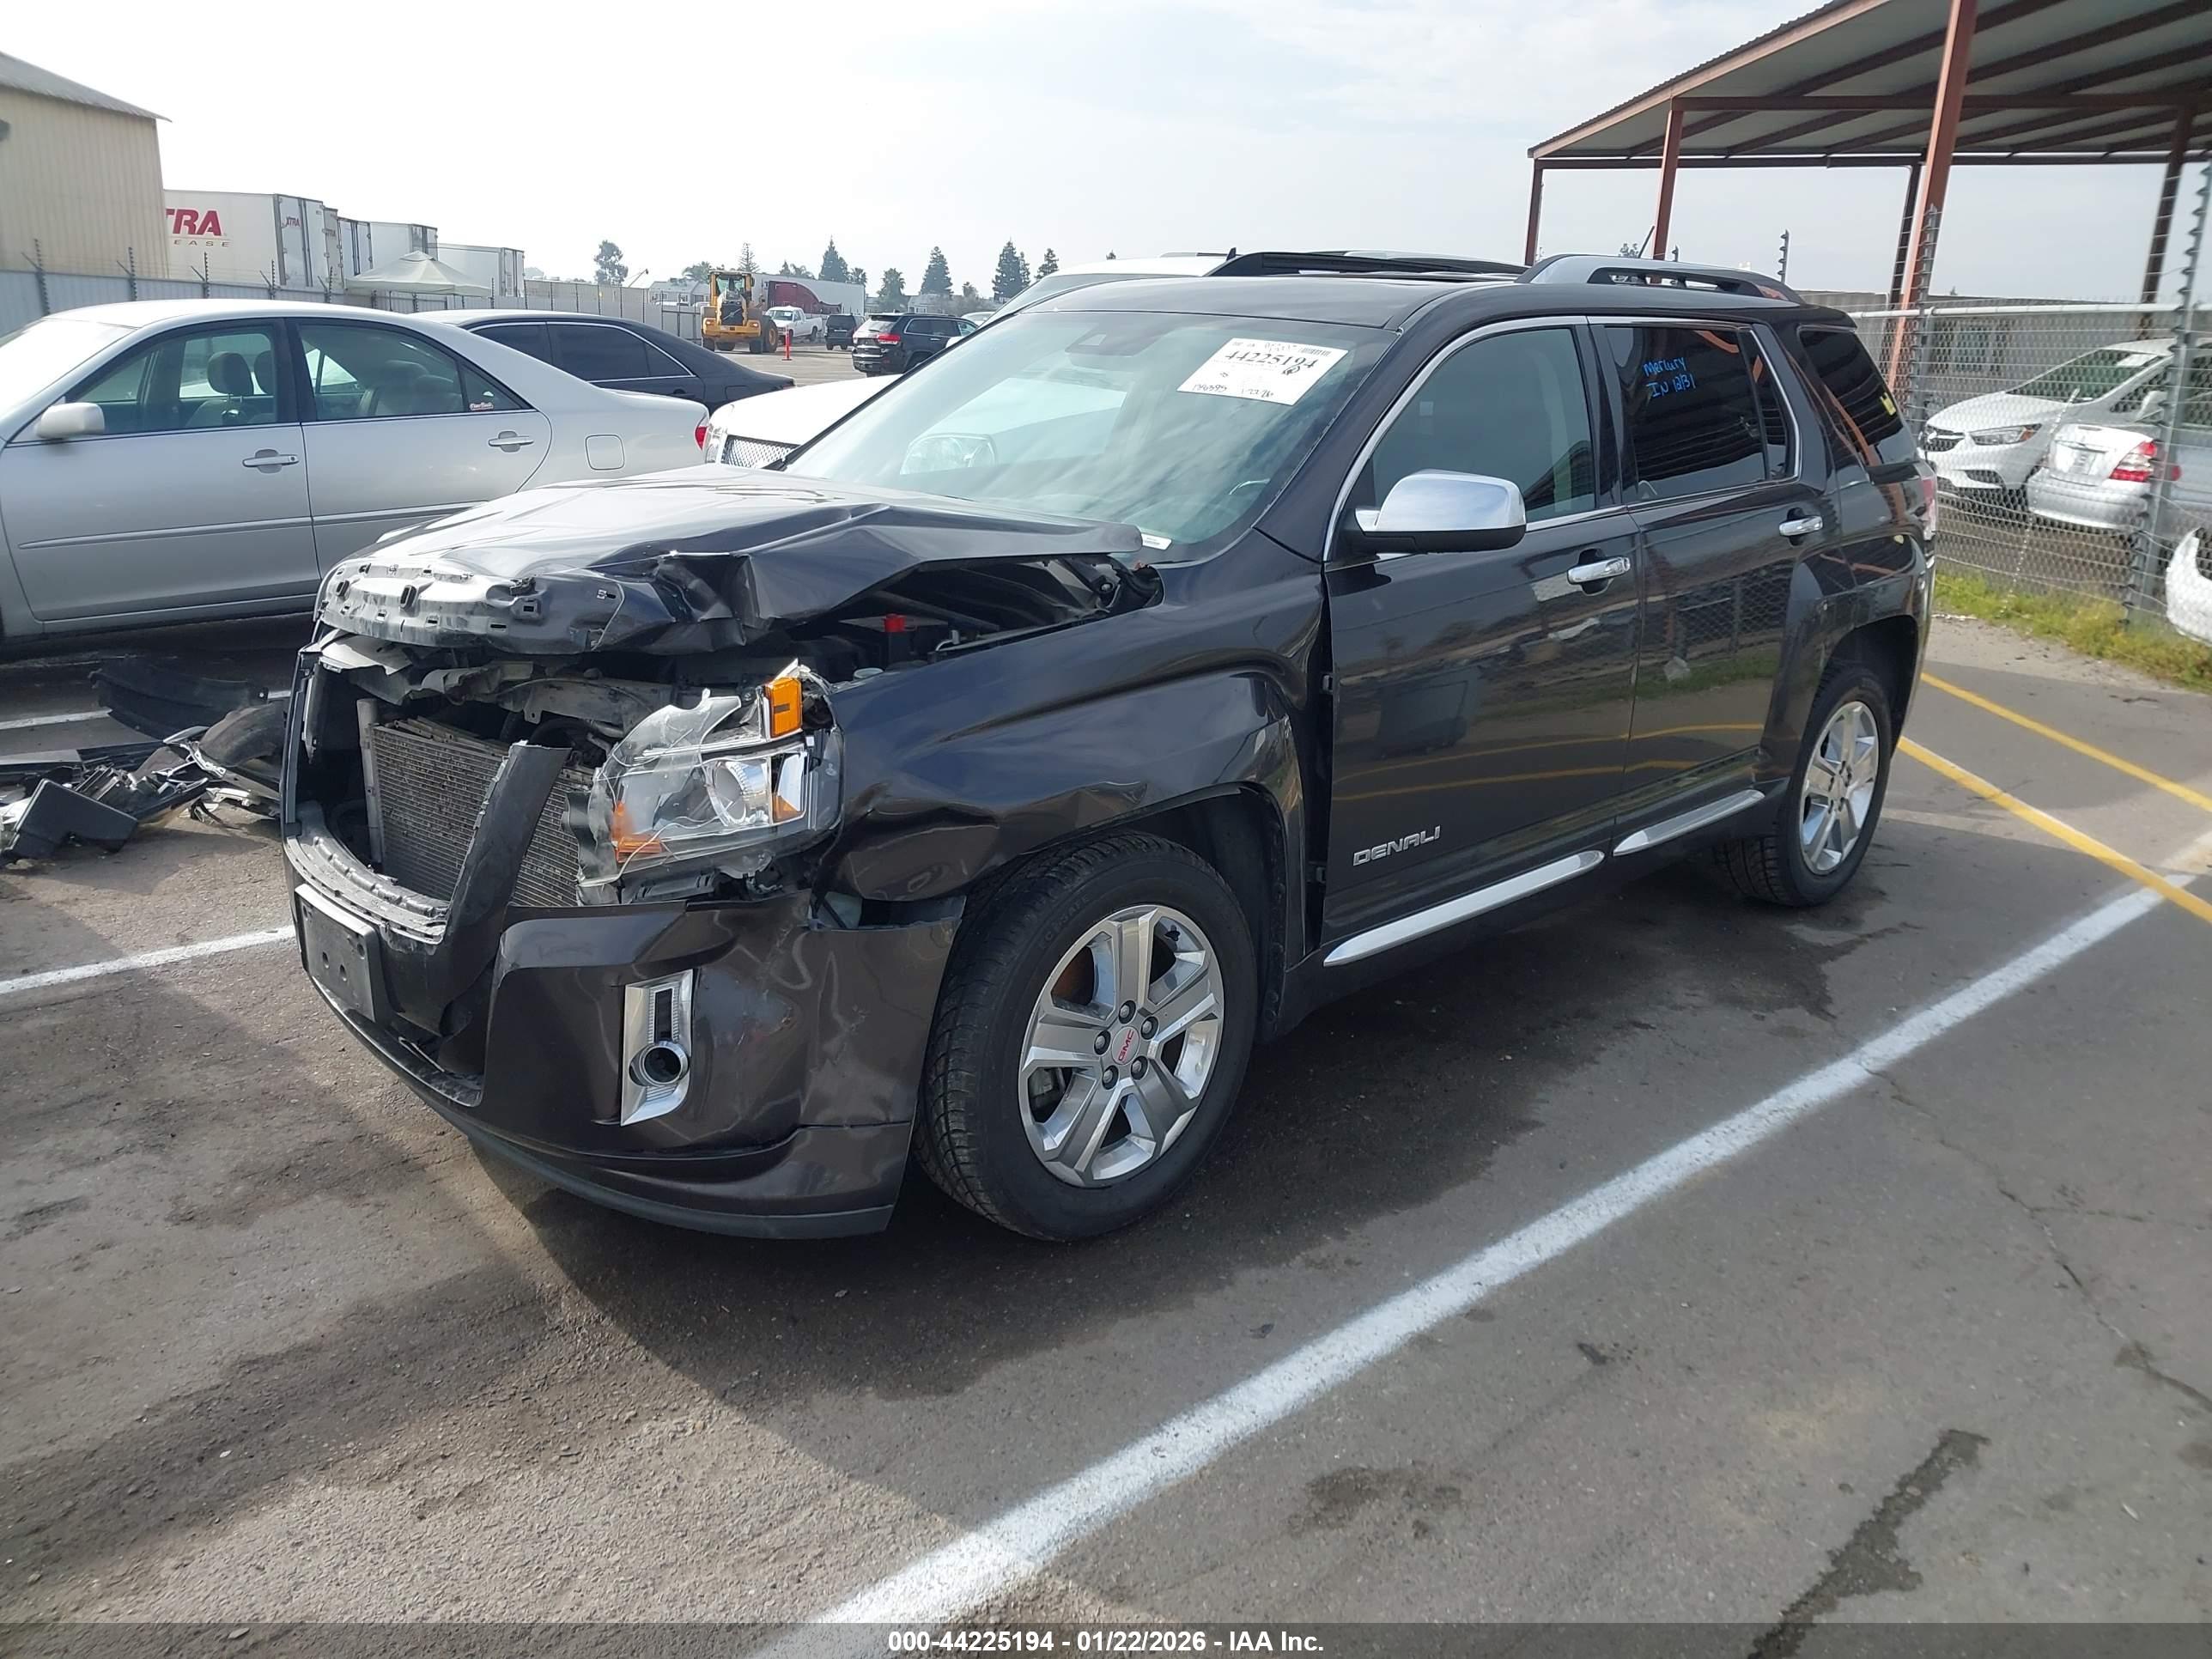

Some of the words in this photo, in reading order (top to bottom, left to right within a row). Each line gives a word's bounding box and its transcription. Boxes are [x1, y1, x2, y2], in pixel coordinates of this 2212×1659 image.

[1224, 350, 1318, 368] 44225194
[1352, 825, 1441, 866] DENALI
[1118, 1030, 1134, 1061] GMC
